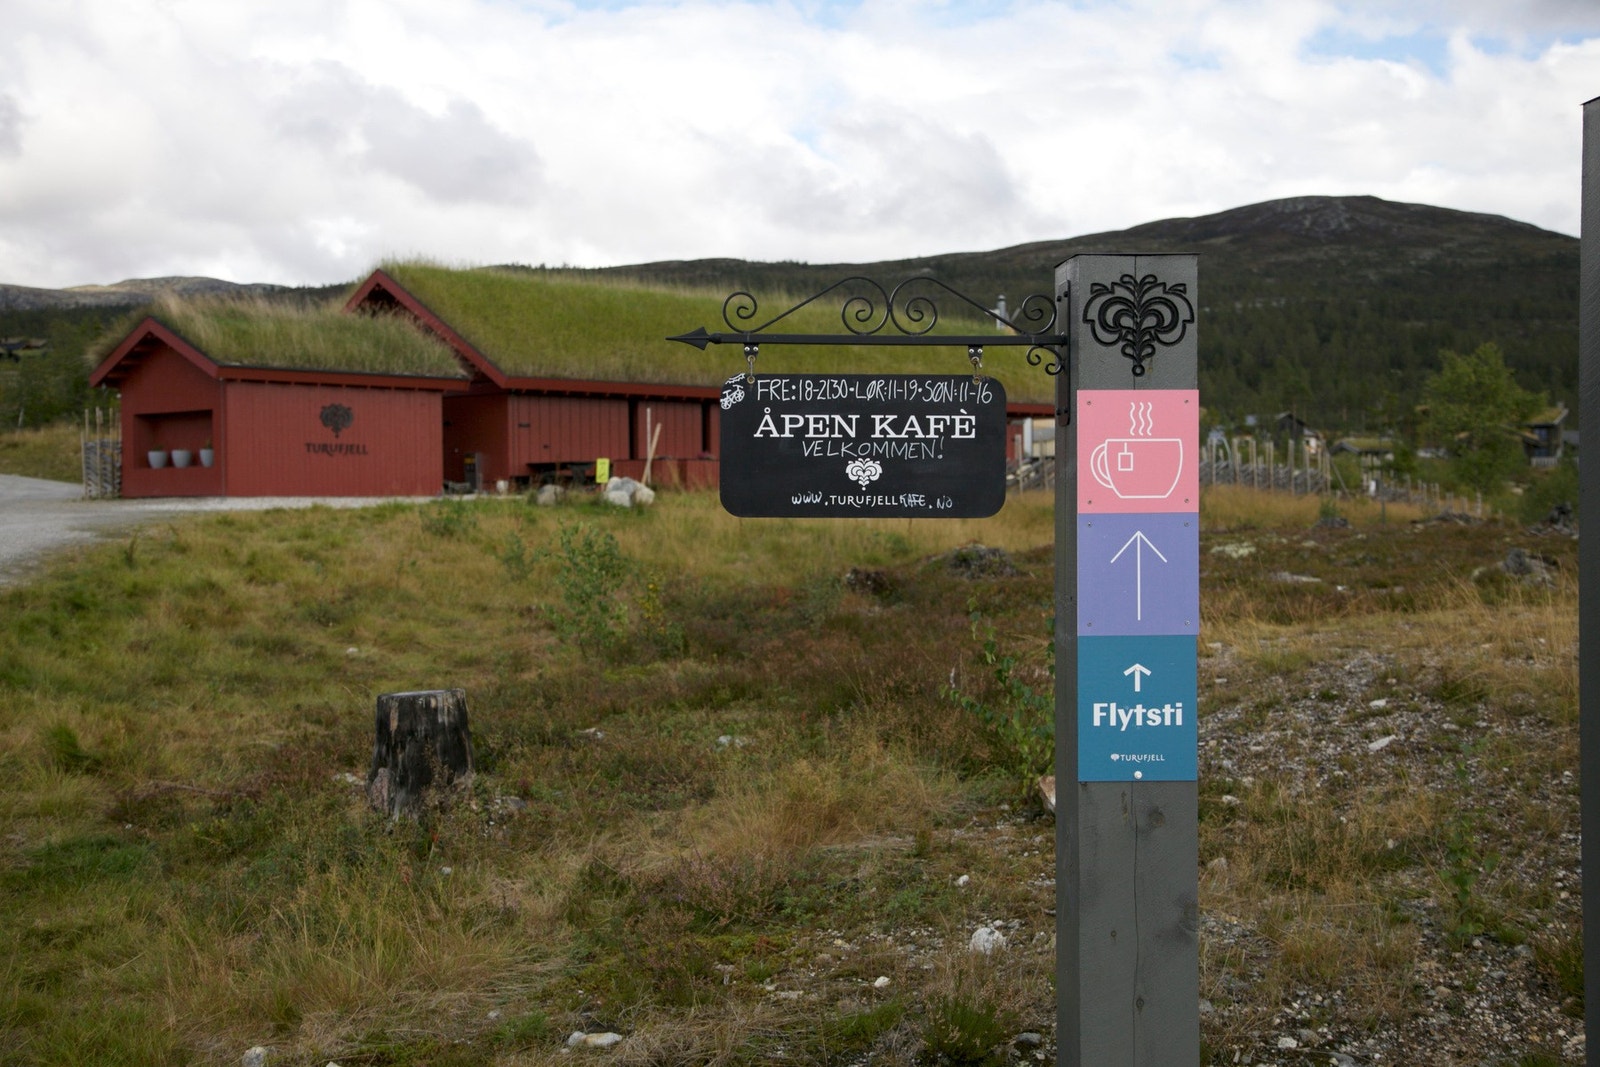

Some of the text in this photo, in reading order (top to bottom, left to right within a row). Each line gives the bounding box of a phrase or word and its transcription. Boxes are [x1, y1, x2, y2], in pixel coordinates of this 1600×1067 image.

[753, 407, 860, 438] ÅPEN
[304, 442, 369, 457] TURUFJELL
[802, 436, 944, 460] VELKOMMEN!
[1093, 702, 1183, 731] Flytsti
[1120, 754, 1165, 763] TURUFJELL
